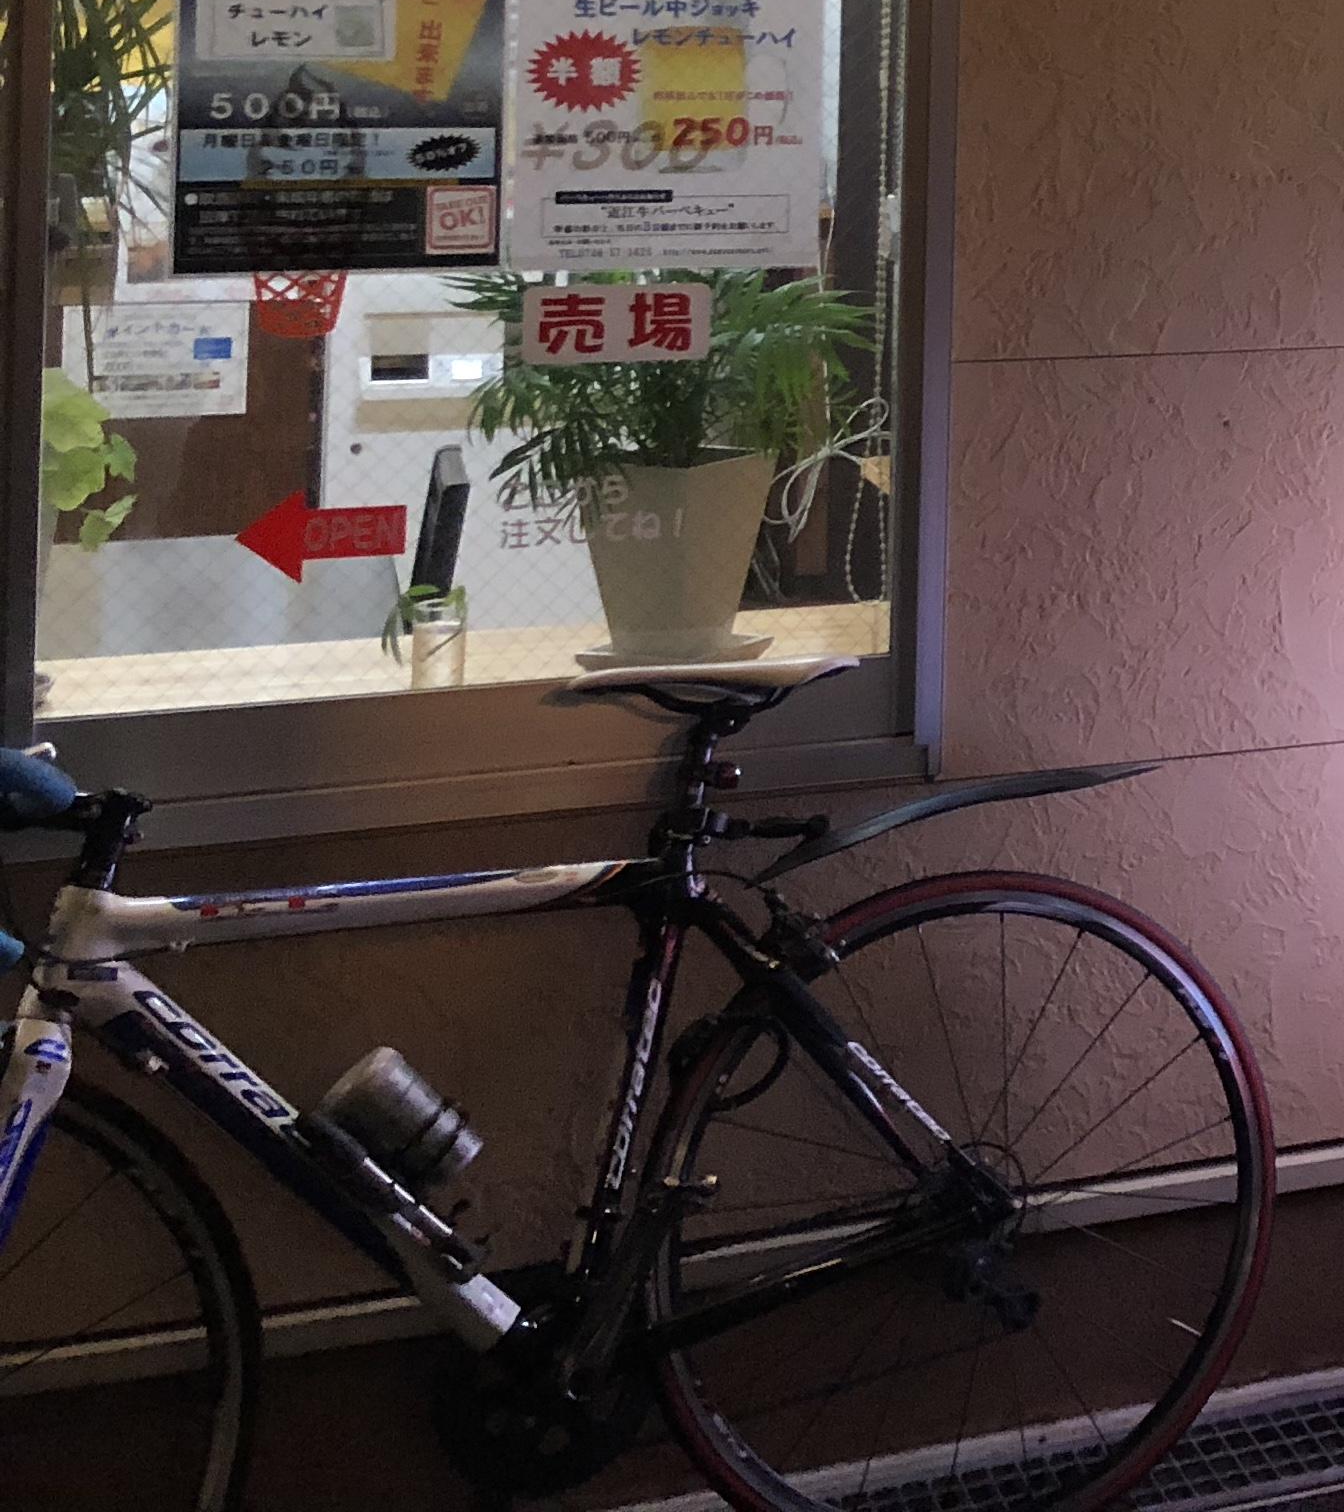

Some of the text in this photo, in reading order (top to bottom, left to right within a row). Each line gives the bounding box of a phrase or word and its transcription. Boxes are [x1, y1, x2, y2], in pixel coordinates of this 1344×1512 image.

[227, 3, 329, 20] チューハイ
[251, 31, 313, 48] レモン
[631, 27, 797, 48] レモンチューハイ
[439, 205, 486, 231] OK!
[536, 293, 695, 357] 売場
[305, 513, 403, 554] OPEN
